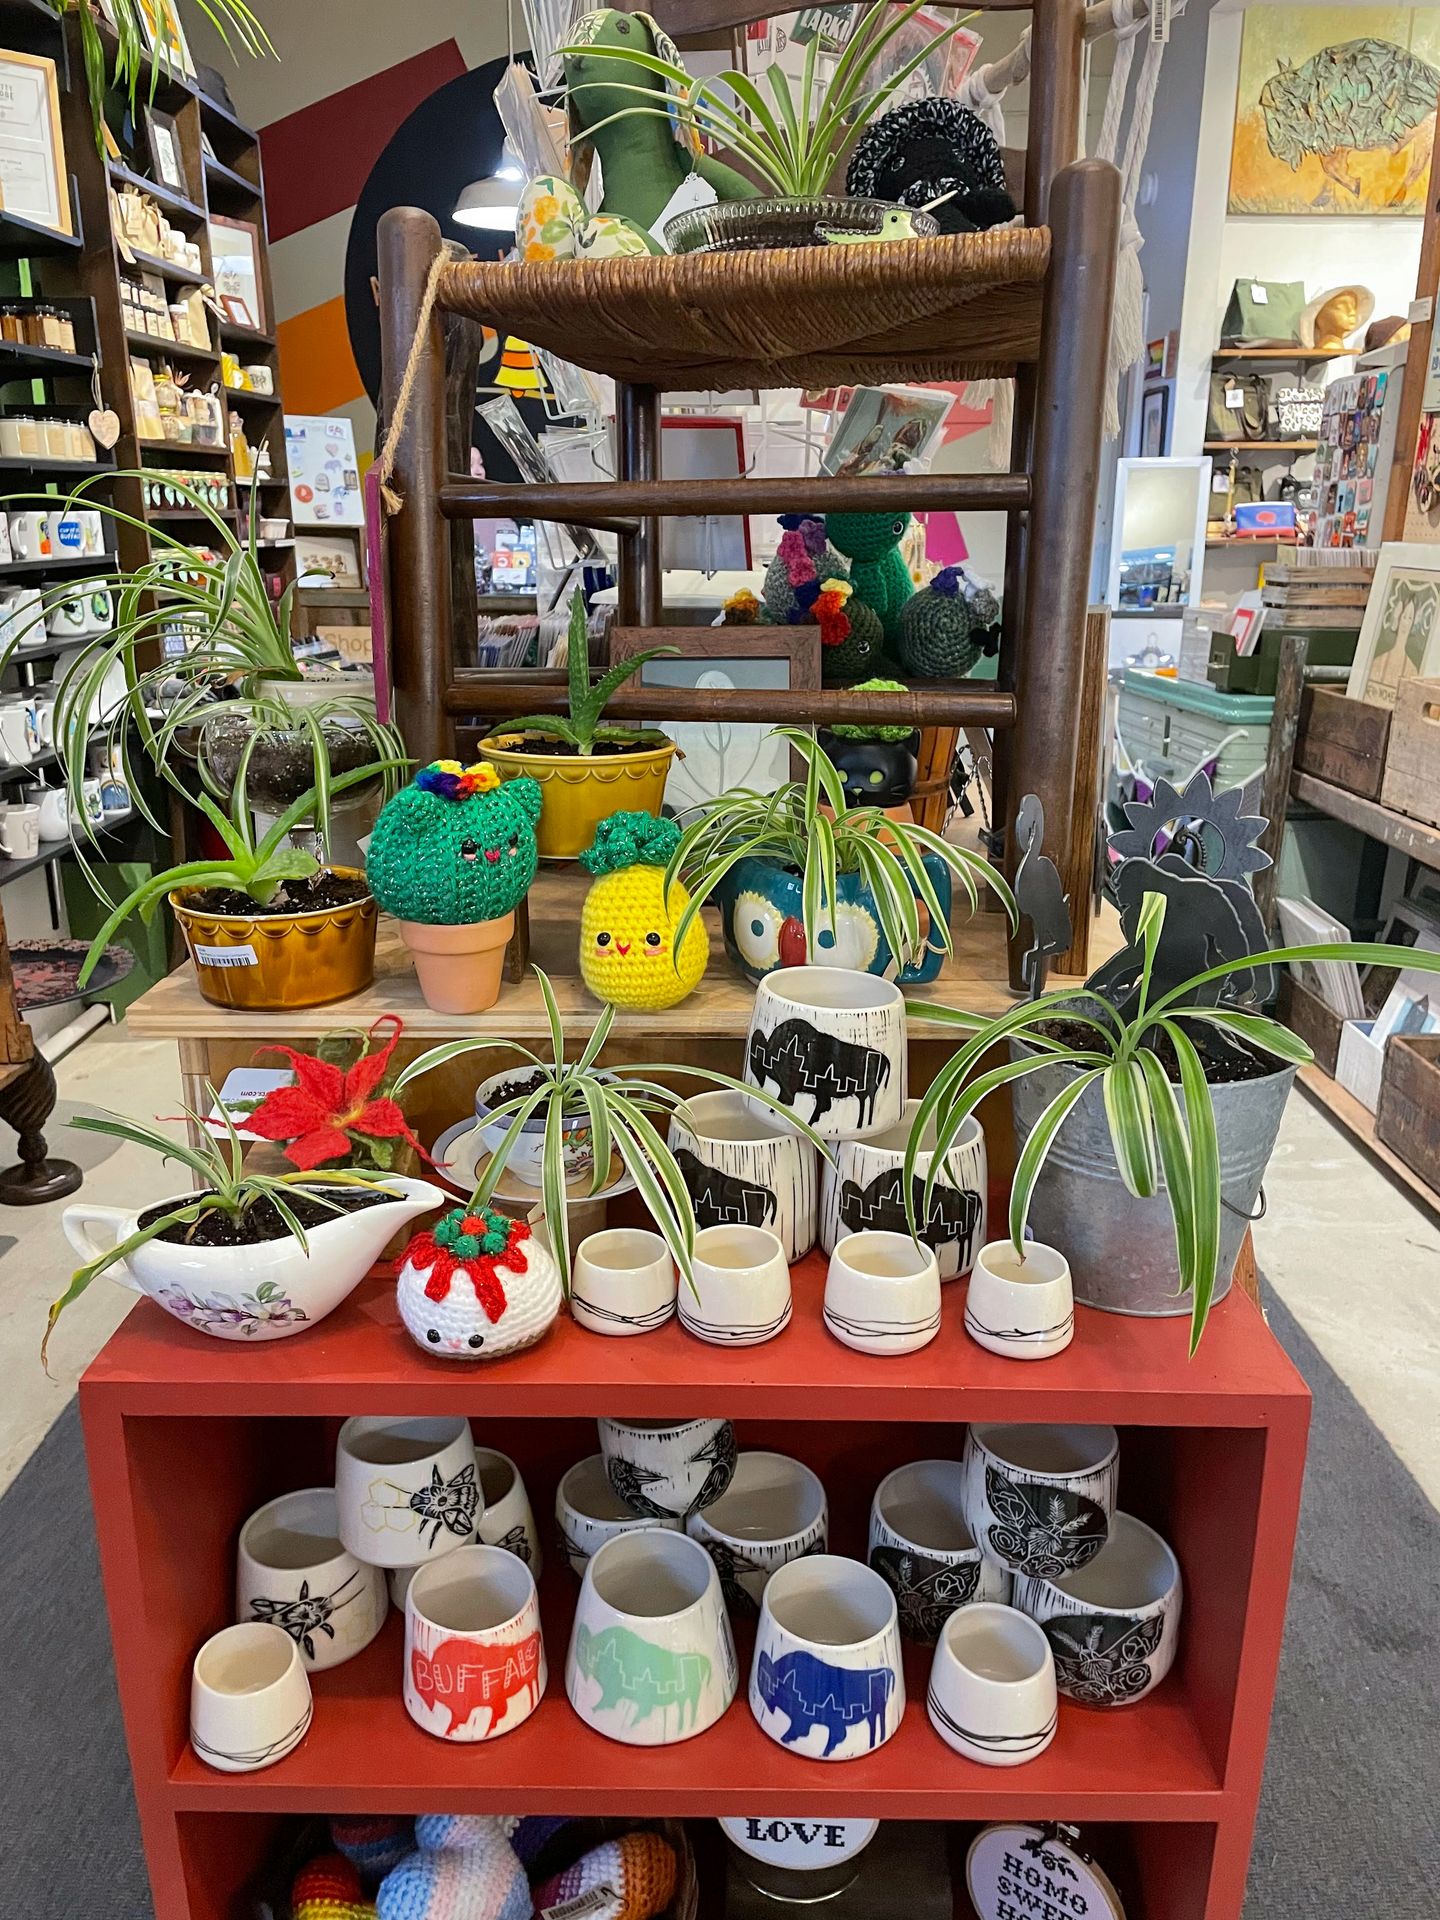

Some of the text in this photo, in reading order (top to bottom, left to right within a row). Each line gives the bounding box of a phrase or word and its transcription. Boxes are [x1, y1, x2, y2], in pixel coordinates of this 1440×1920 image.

[416, 1638, 538, 1700] BUFFALO
[746, 1817, 845, 1848] LOVE
[1002, 1851, 1089, 1915] HOMO
